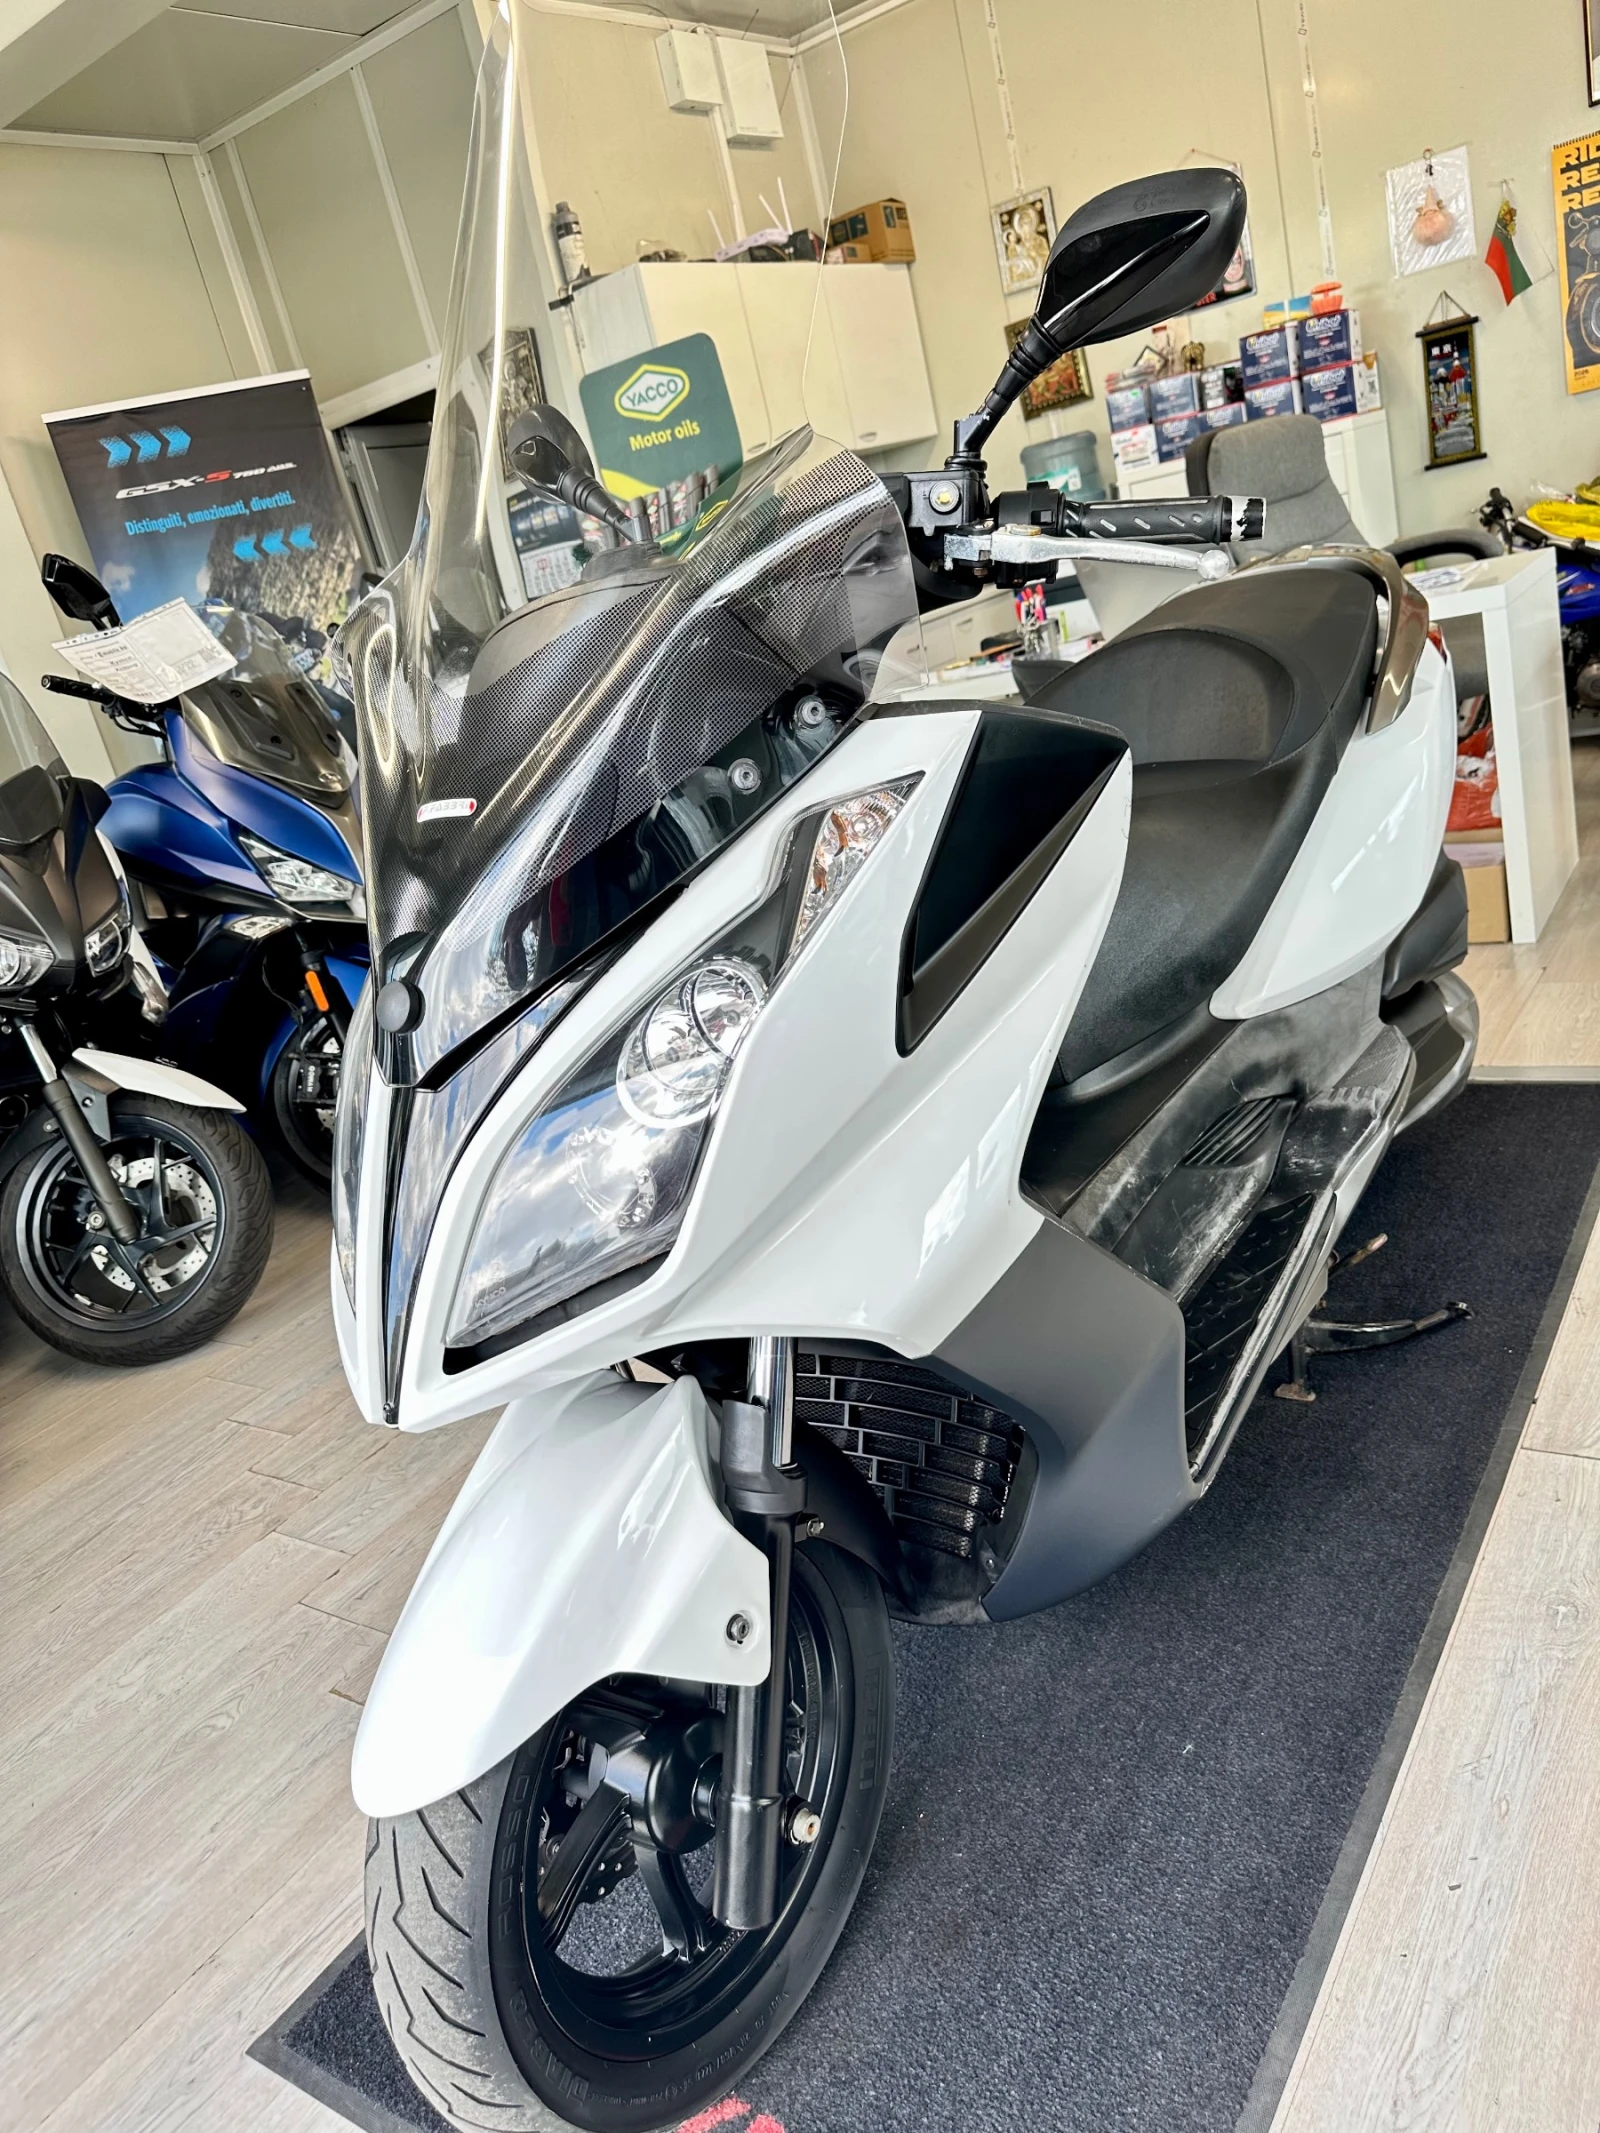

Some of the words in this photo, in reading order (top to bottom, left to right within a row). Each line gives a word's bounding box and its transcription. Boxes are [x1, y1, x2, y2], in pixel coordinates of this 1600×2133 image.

[626, 379, 679, 407] YACCO
[629, 428, 672, 451] Motor
[674, 419, 701, 440] oils
[124, 511, 187, 536] Distinguiti,
[187, 499, 250, 525] emozionati,
[250, 490, 296, 512] divertiti.
[499, 1774, 529, 1937] ROSSO
[510, 1988, 590, 2106] DIABLO
